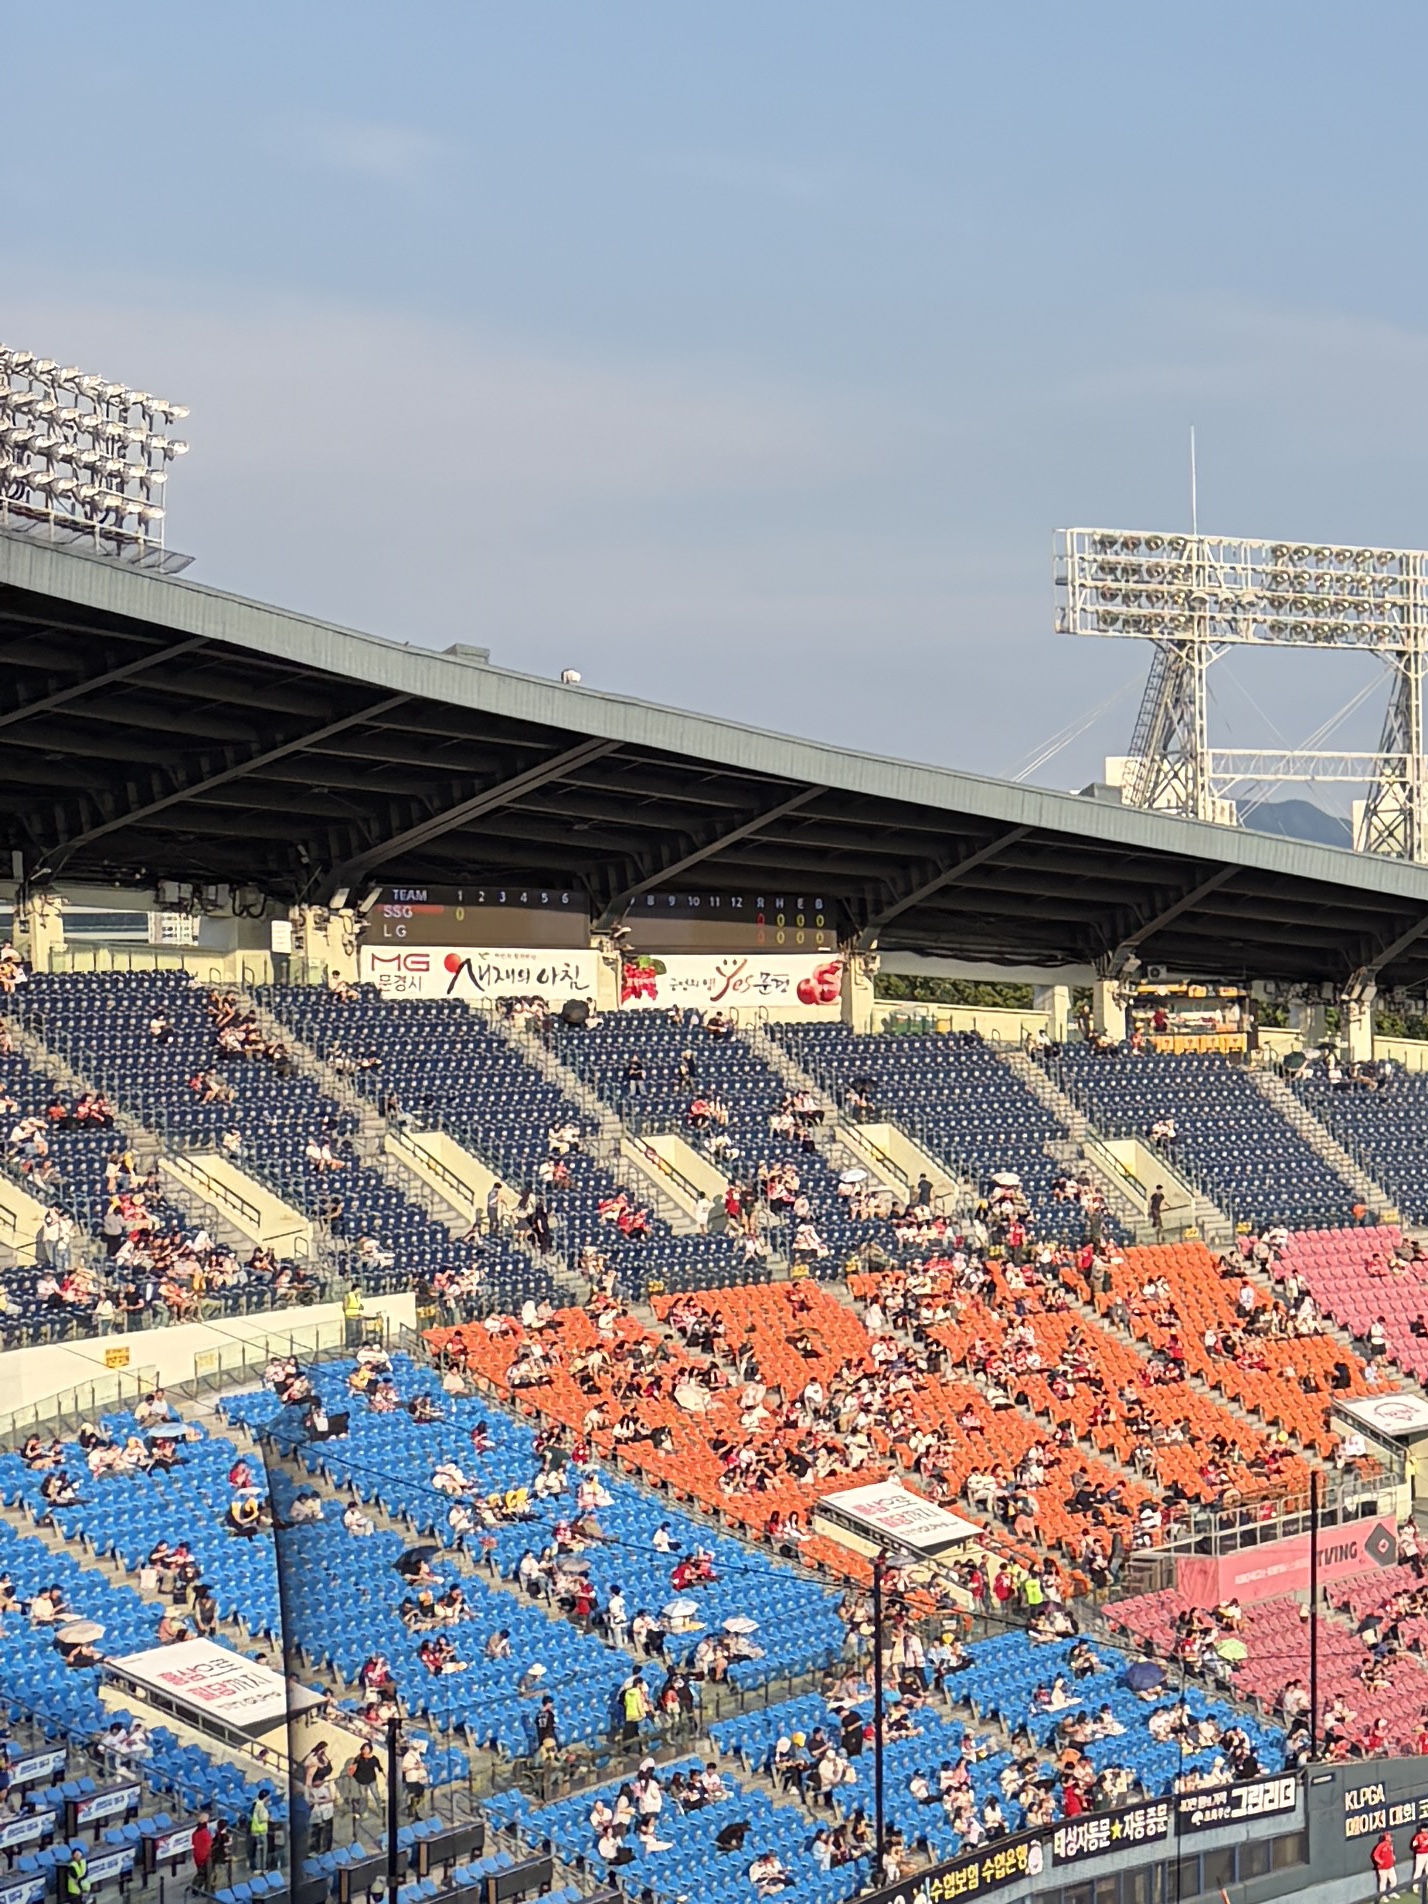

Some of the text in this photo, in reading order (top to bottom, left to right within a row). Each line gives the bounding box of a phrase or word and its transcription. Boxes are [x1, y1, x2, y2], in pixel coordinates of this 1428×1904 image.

[393, 889, 569, 904] TEAM 1 2 3 4 5 6
[669, 895, 676, 906] 9
[688, 896, 700, 907] 10
[731, 897, 743, 908] 12
[797, 898, 804, 909] E
[383, 905, 465, 921] SSG 0
[776, 913, 785, 927] 0
[796, 913, 805, 927] 0
[816, 914, 825, 927] 0
[776, 931, 785, 944] 0
[796, 931, 805, 944] 0
[816, 931, 824, 944] 0
[371, 953, 430, 972] MG
[379, 974, 422, 992] 문경시
[536, 963, 590, 990] 아침
[1345, 1783, 1386, 1811] KLPGA
